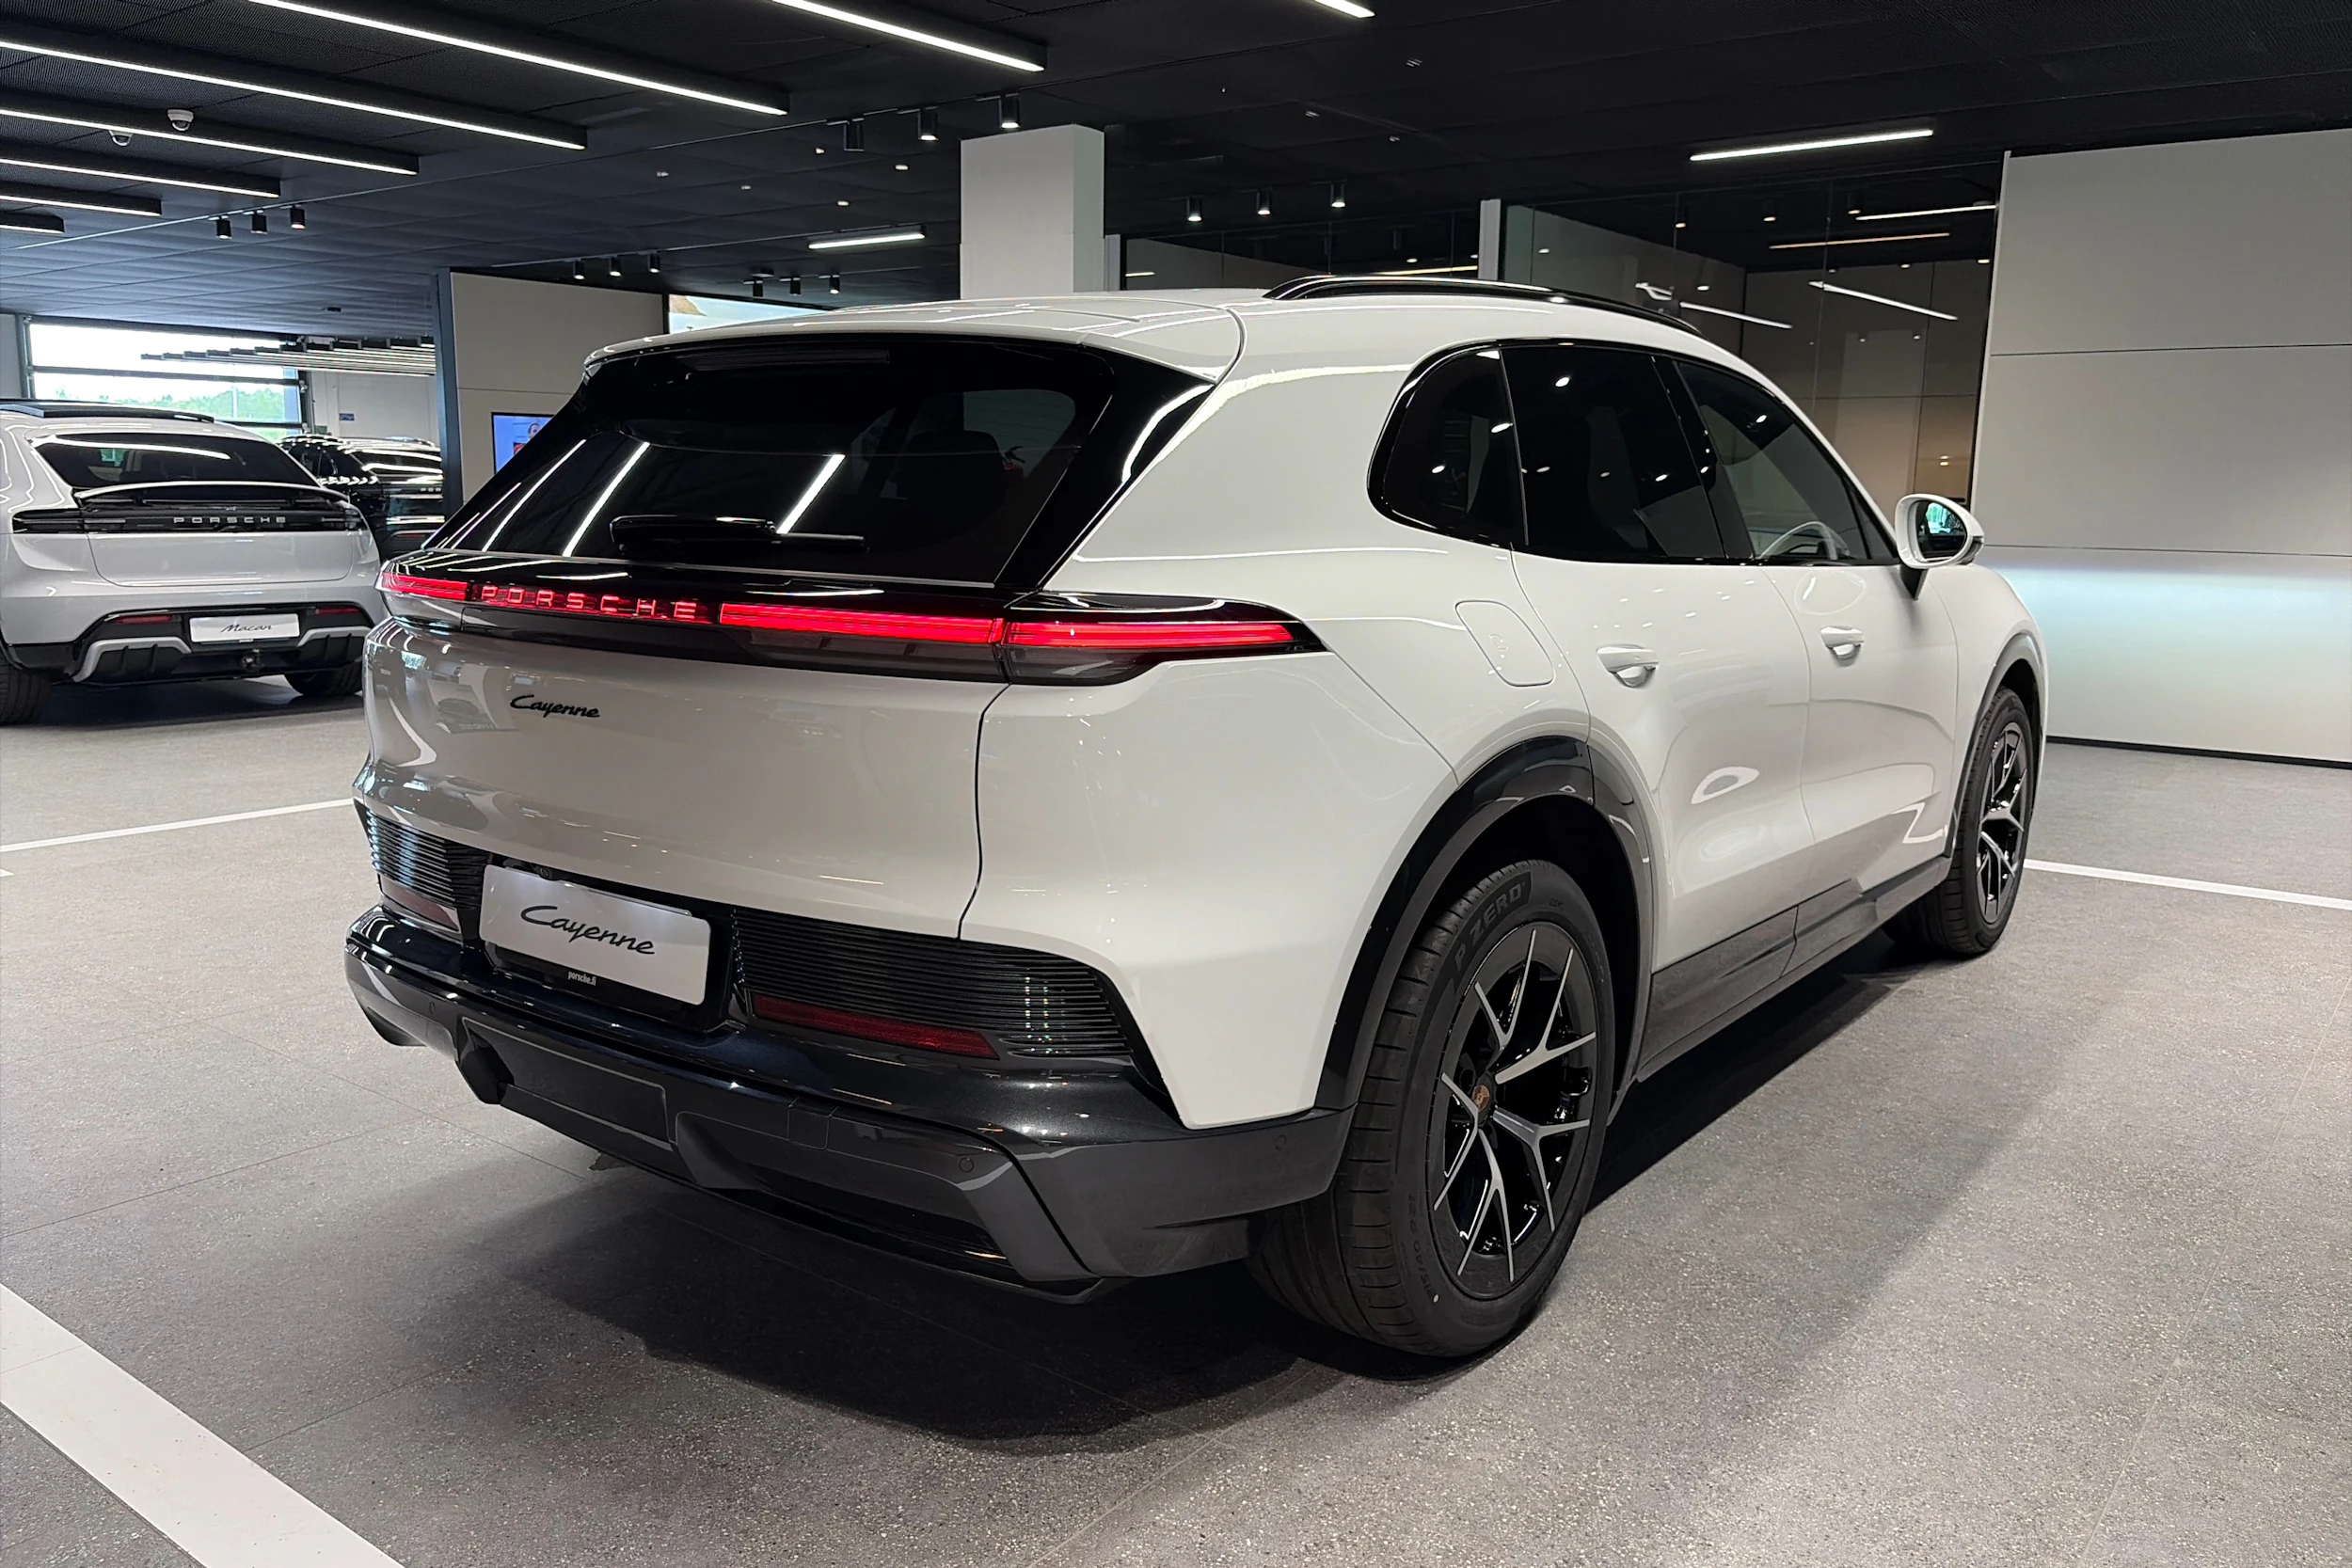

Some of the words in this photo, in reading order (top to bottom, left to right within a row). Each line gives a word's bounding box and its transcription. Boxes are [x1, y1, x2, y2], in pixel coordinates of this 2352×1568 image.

[481, 585, 697, 620] PORSCHE
[220, 624, 273, 633] Macan
[509, 695, 600, 718] Cayenne
[520, 906, 655, 955] Cayenne
[1454, 942, 1467, 973] P
[1470, 883, 1522, 947] ZERO
[567, 971, 596, 986] porsche.fi
